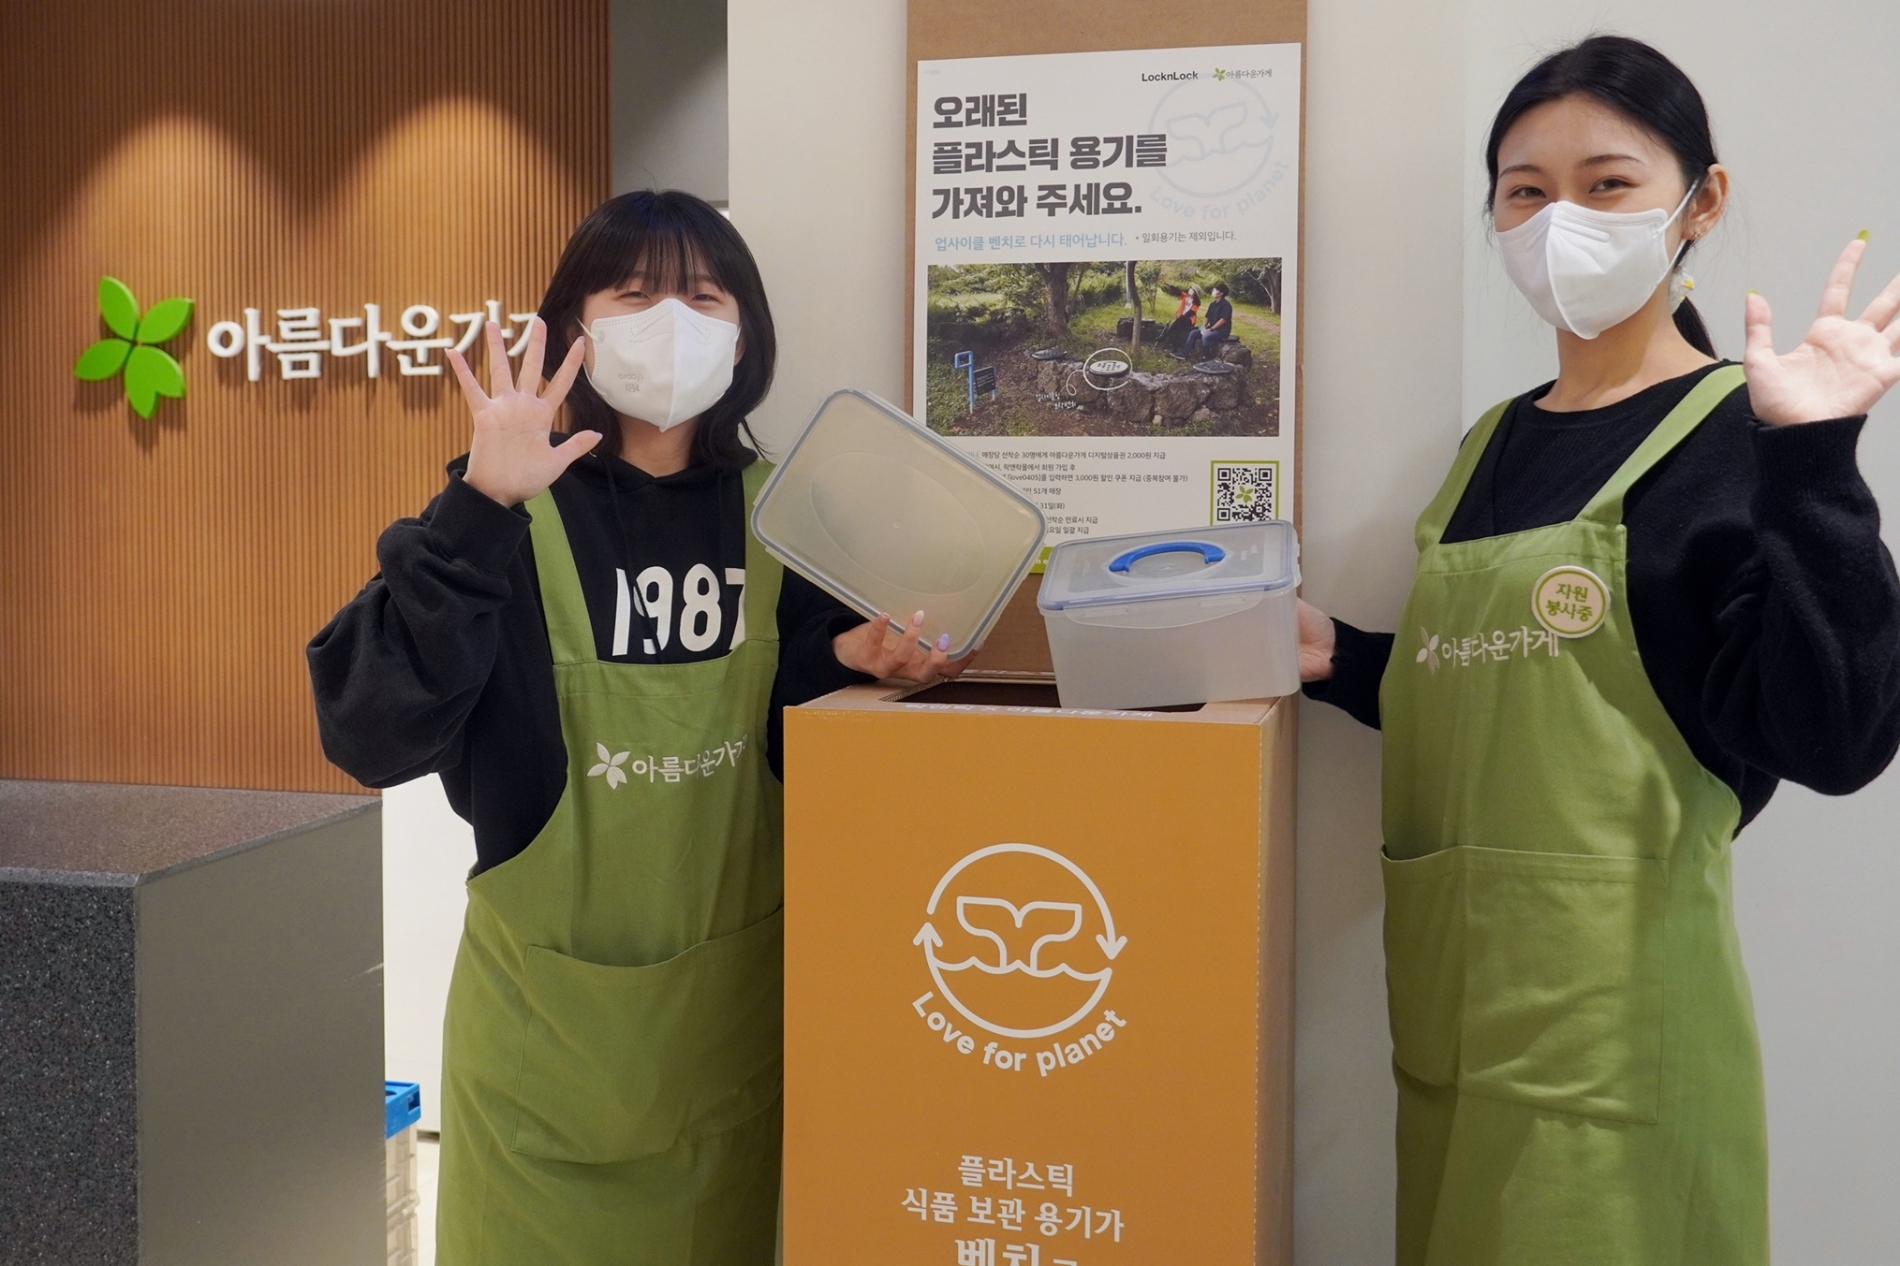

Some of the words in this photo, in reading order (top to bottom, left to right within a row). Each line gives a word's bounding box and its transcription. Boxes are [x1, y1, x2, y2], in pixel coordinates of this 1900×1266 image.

[1141, 71, 1199, 82] LocknLock
[1225, 68, 1273, 79] 아름다운가게
[932, 93, 1028, 128] 오래된
[932, 138, 1059, 175] 플라스틱
[1069, 133, 1168, 170] 용기를
[931, 186, 1028, 219] 가져와
[1036, 181, 1142, 216] 주세요.
[1149, 186, 1195, 218] Love
[1202, 204, 1231, 220] for
[1236, 160, 1289, 216] planet
[934, 235, 985, 252] 업사이클
[989, 235, 1027, 250] 벤치로
[1030, 233, 1055, 250] 다시
[1059, 232, 1128, 249] 태어납니다.
[1141, 232, 1187, 244] 일회용기는
[1188, 230, 1237, 242] 제외입니다.
[1022, 451, 1048, 459] 30명에게
[1049, 451, 1086, 459] 아름다운가게
[1088, 451, 1125, 460] 디지털상품권
[1127, 452, 1152, 460] 2,000원
[1153, 452, 1166, 460] 지급
[1042, 463, 1054, 471] 회원
[1055, 463, 1068, 471] 가입
[1069, 463, 1076, 471] 후
[1075, 474, 1099, 482] 3,000원
[1100, 474, 1114, 482] 할인
[1115, 474, 1127, 483] 쿠폰
[1128, 474, 1142, 483] 지급
[1033, 487, 1048, 495] 51개
[1077, 526, 1090, 534] 지급
[1085, 516, 1098, 524] 지급
[1555, 583, 1589, 602] 자원
[611, 562, 746, 657] 1987
[1545, 599, 1593, 622] 봉사중
[1441, 625, 1559, 668] 아름다운가게
[911, 990, 975, 1055] Love
[982, 1041, 1026, 1072] for
[1036, 1008, 1127, 1077] planet
[957, 1154, 1074, 1197] 플라스틱
[901, 1187, 959, 1224] 식품
[966, 1194, 1025, 1231] 보관
[1034, 1201, 1125, 1243] 용기가
